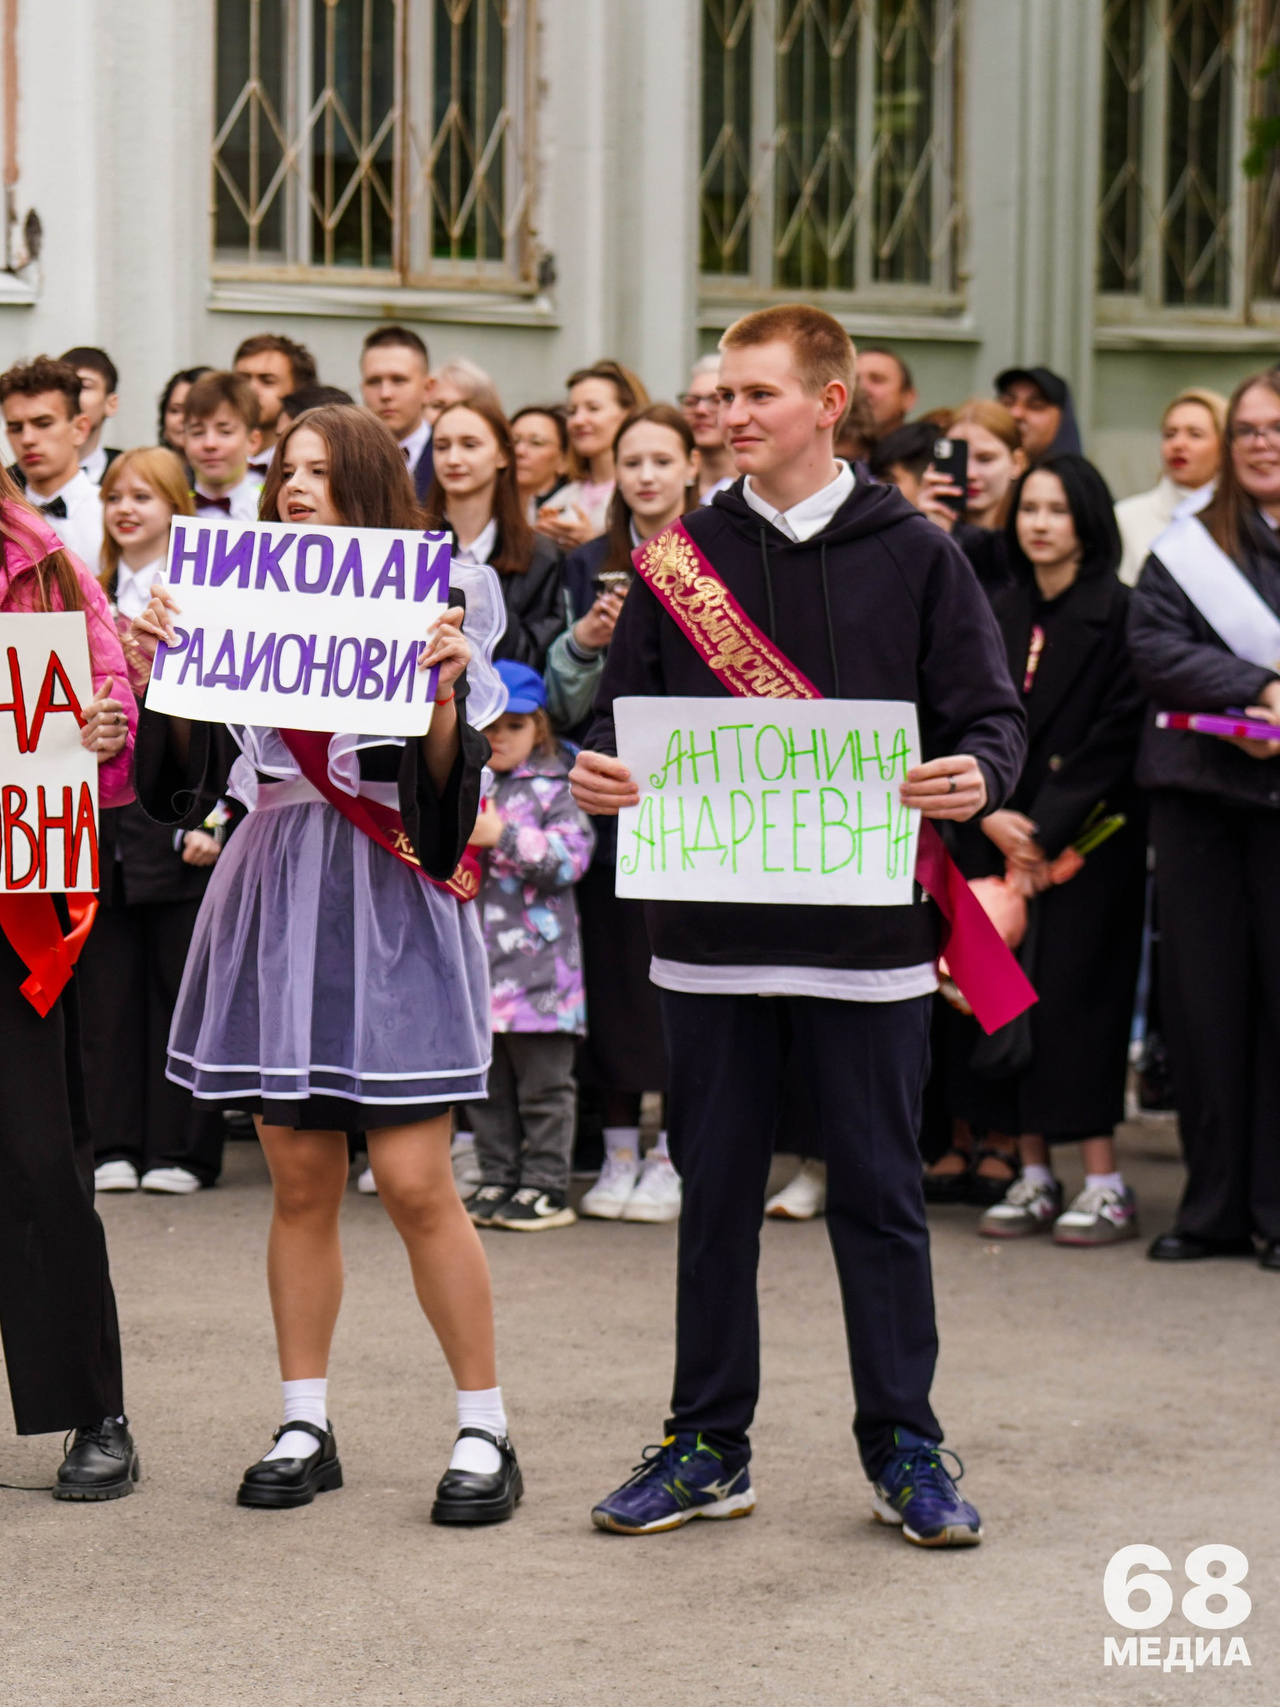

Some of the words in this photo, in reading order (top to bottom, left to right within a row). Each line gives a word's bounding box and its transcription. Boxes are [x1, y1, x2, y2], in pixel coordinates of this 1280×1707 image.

[168, 526, 452, 604] НИКОЛАЙ
[673, 574, 801, 700] Выпускн
[649, 723, 912, 790] АНТОНИНА
[620, 786, 914, 880] АНДРЕЕВНА
